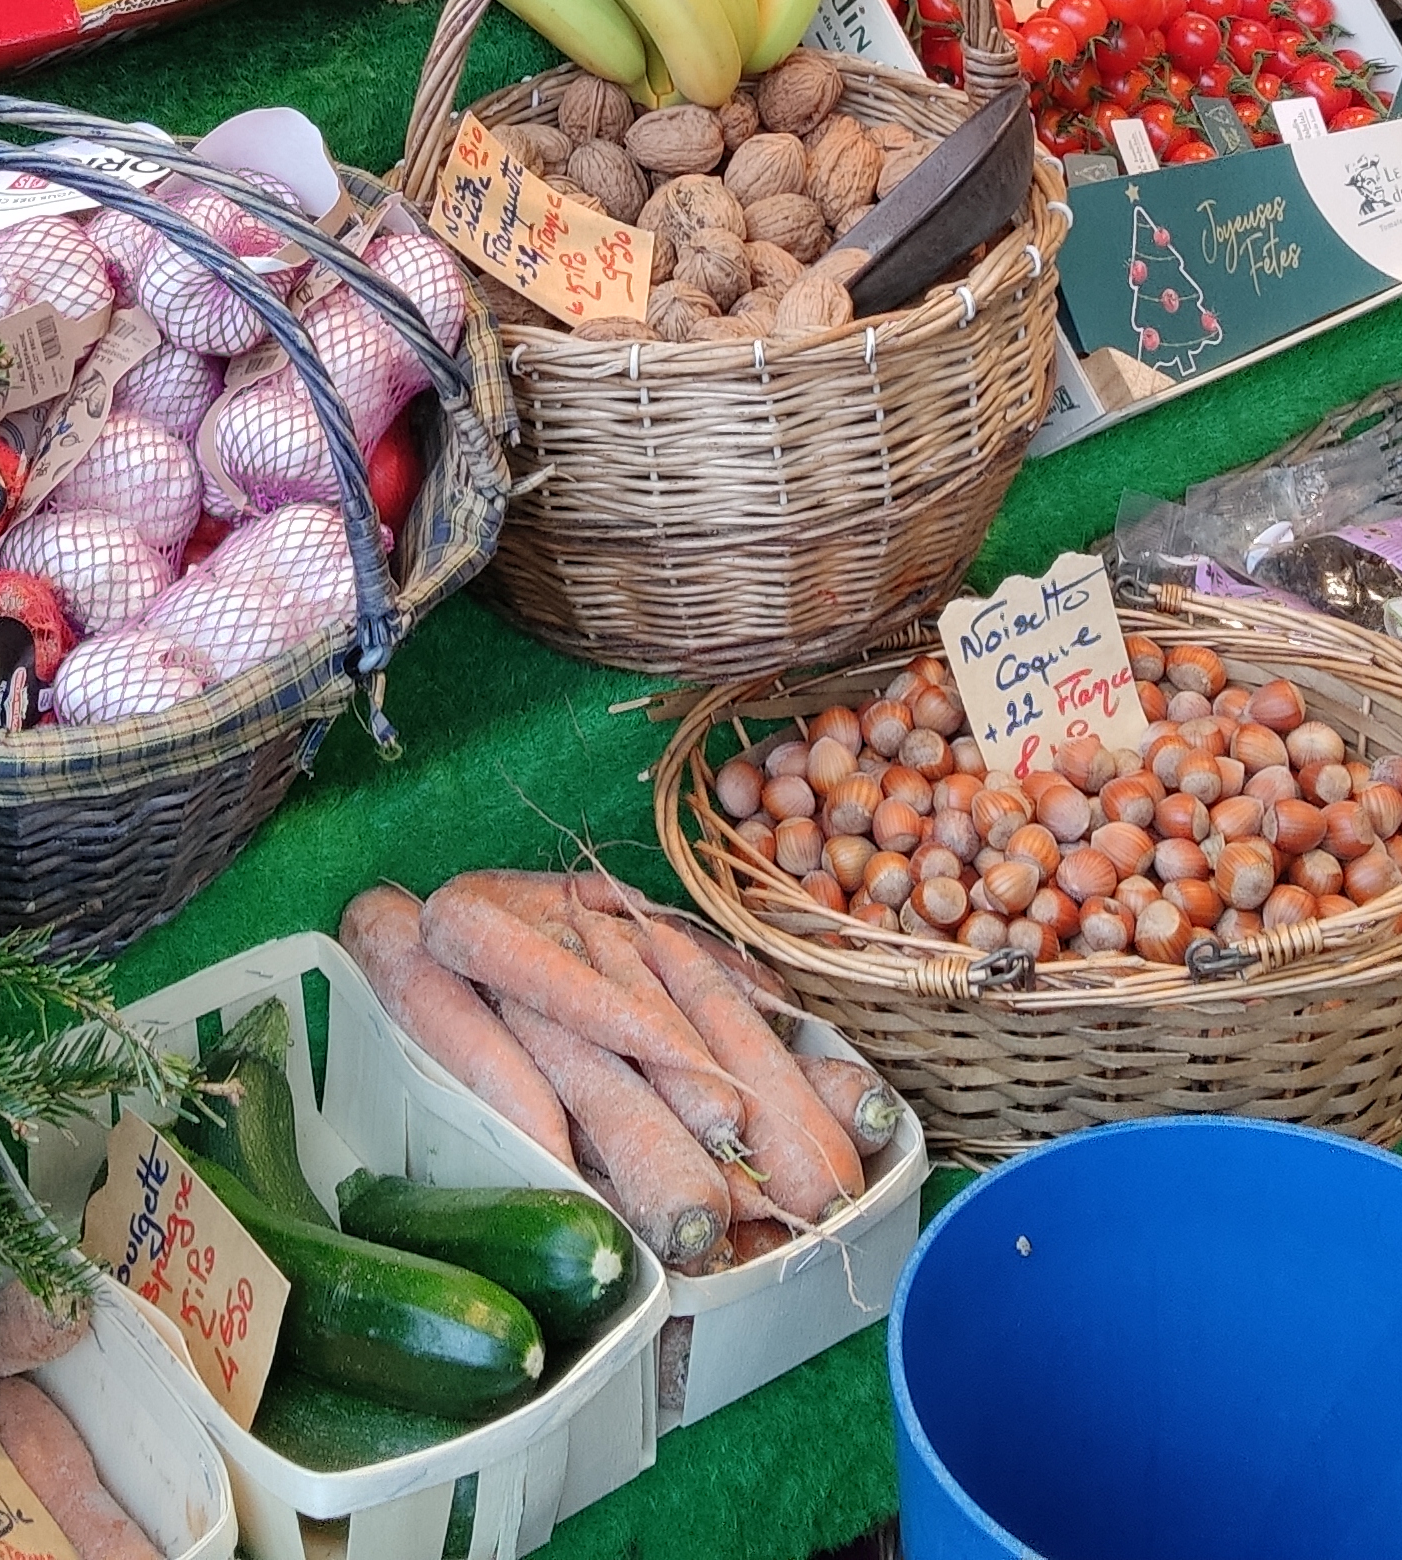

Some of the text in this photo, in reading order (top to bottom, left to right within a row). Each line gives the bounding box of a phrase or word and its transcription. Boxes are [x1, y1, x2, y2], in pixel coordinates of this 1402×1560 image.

[1195, 194, 1287, 273] Joyeuses
[1238, 220, 1302, 298] Fêtes
[115, 1132, 170, 1287] ourgette
